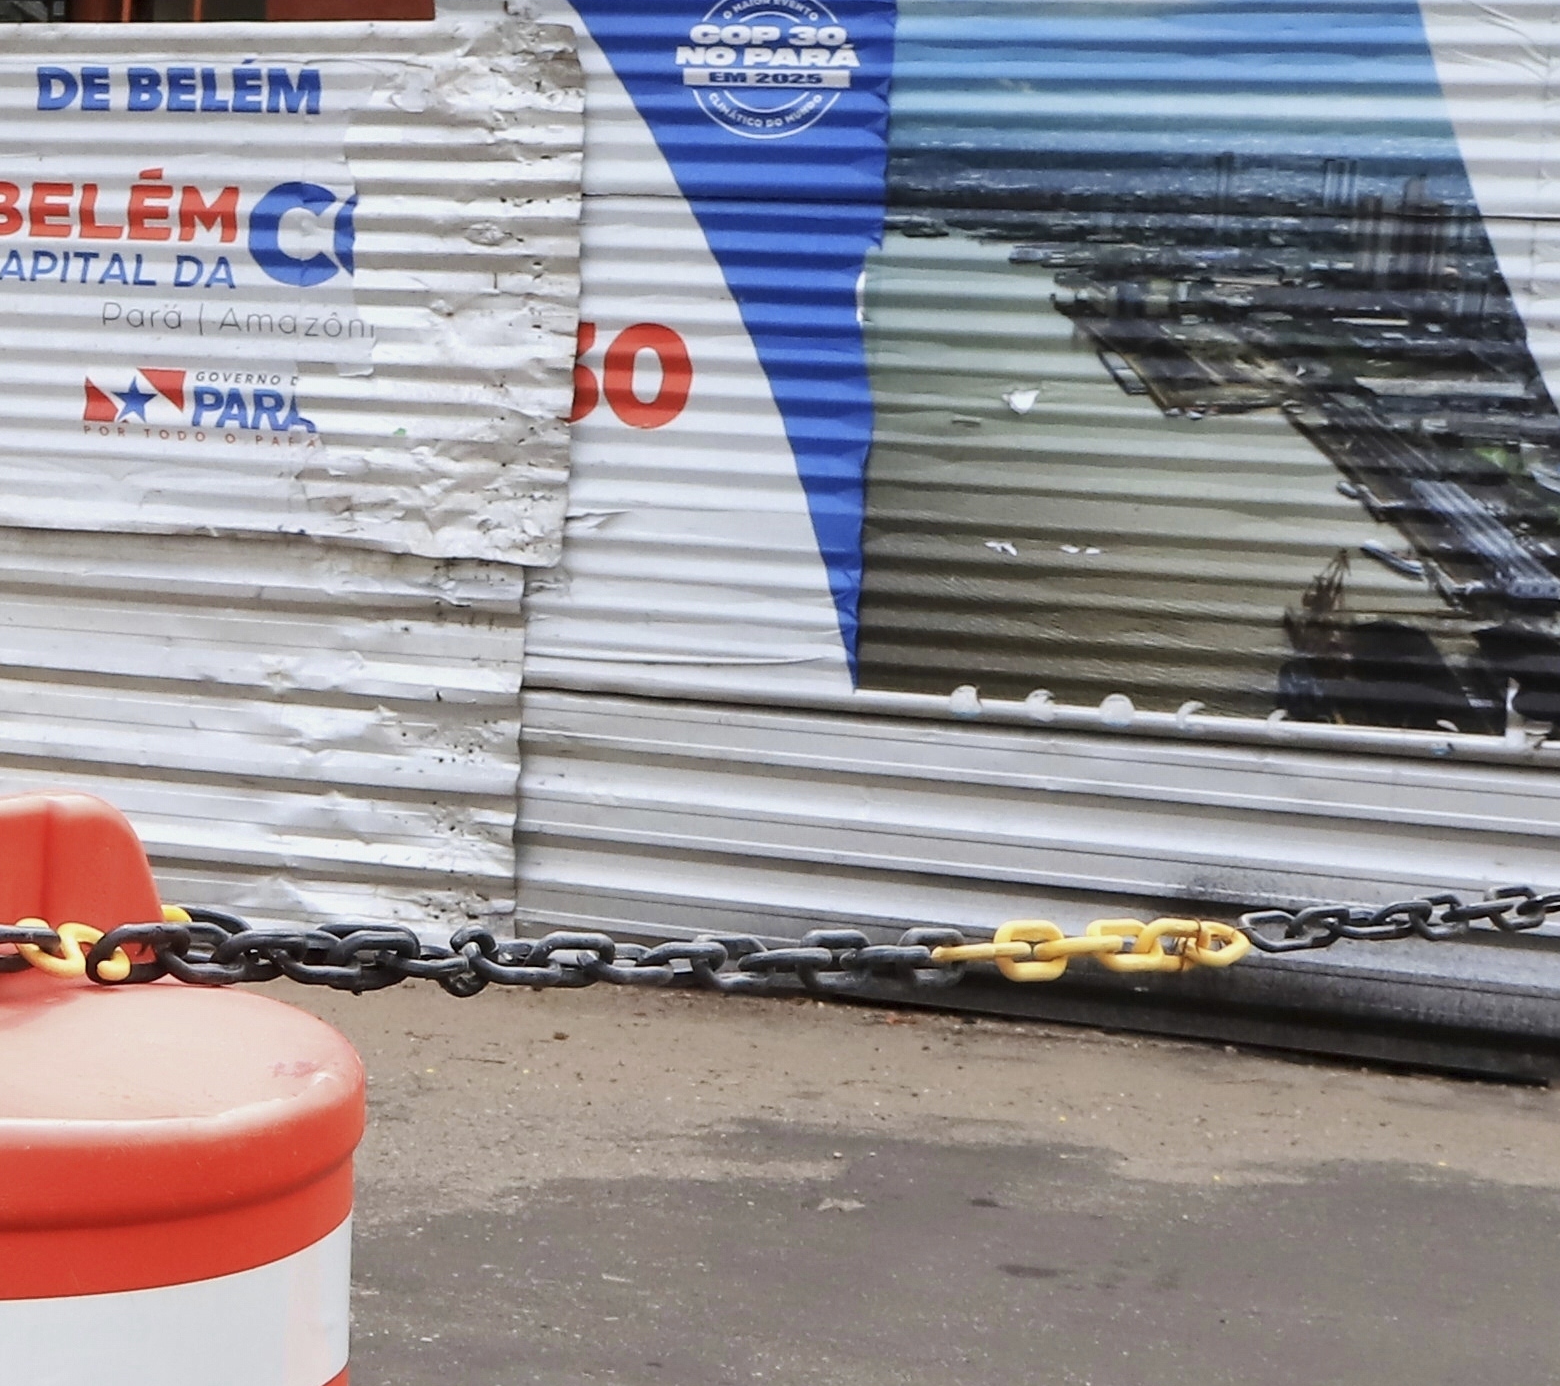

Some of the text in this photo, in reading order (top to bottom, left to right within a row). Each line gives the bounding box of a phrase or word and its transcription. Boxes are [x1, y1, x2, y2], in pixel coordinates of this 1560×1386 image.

[690, 24, 847, 46] COP 30
[675, 43, 860, 67] NO PARÁ
[37, 59, 320, 115] DE BELÉM
[709, 72, 823, 84] EM 2025
[765, 118, 784, 128] DO
[247, 180, 359, 288] C
[173, 255, 236, 289] DA
[196, 371, 280, 386] GOVERNO
[83, 424, 126, 437] POR
[144, 427, 207, 443] TODO
[225, 433, 236, 444] O
